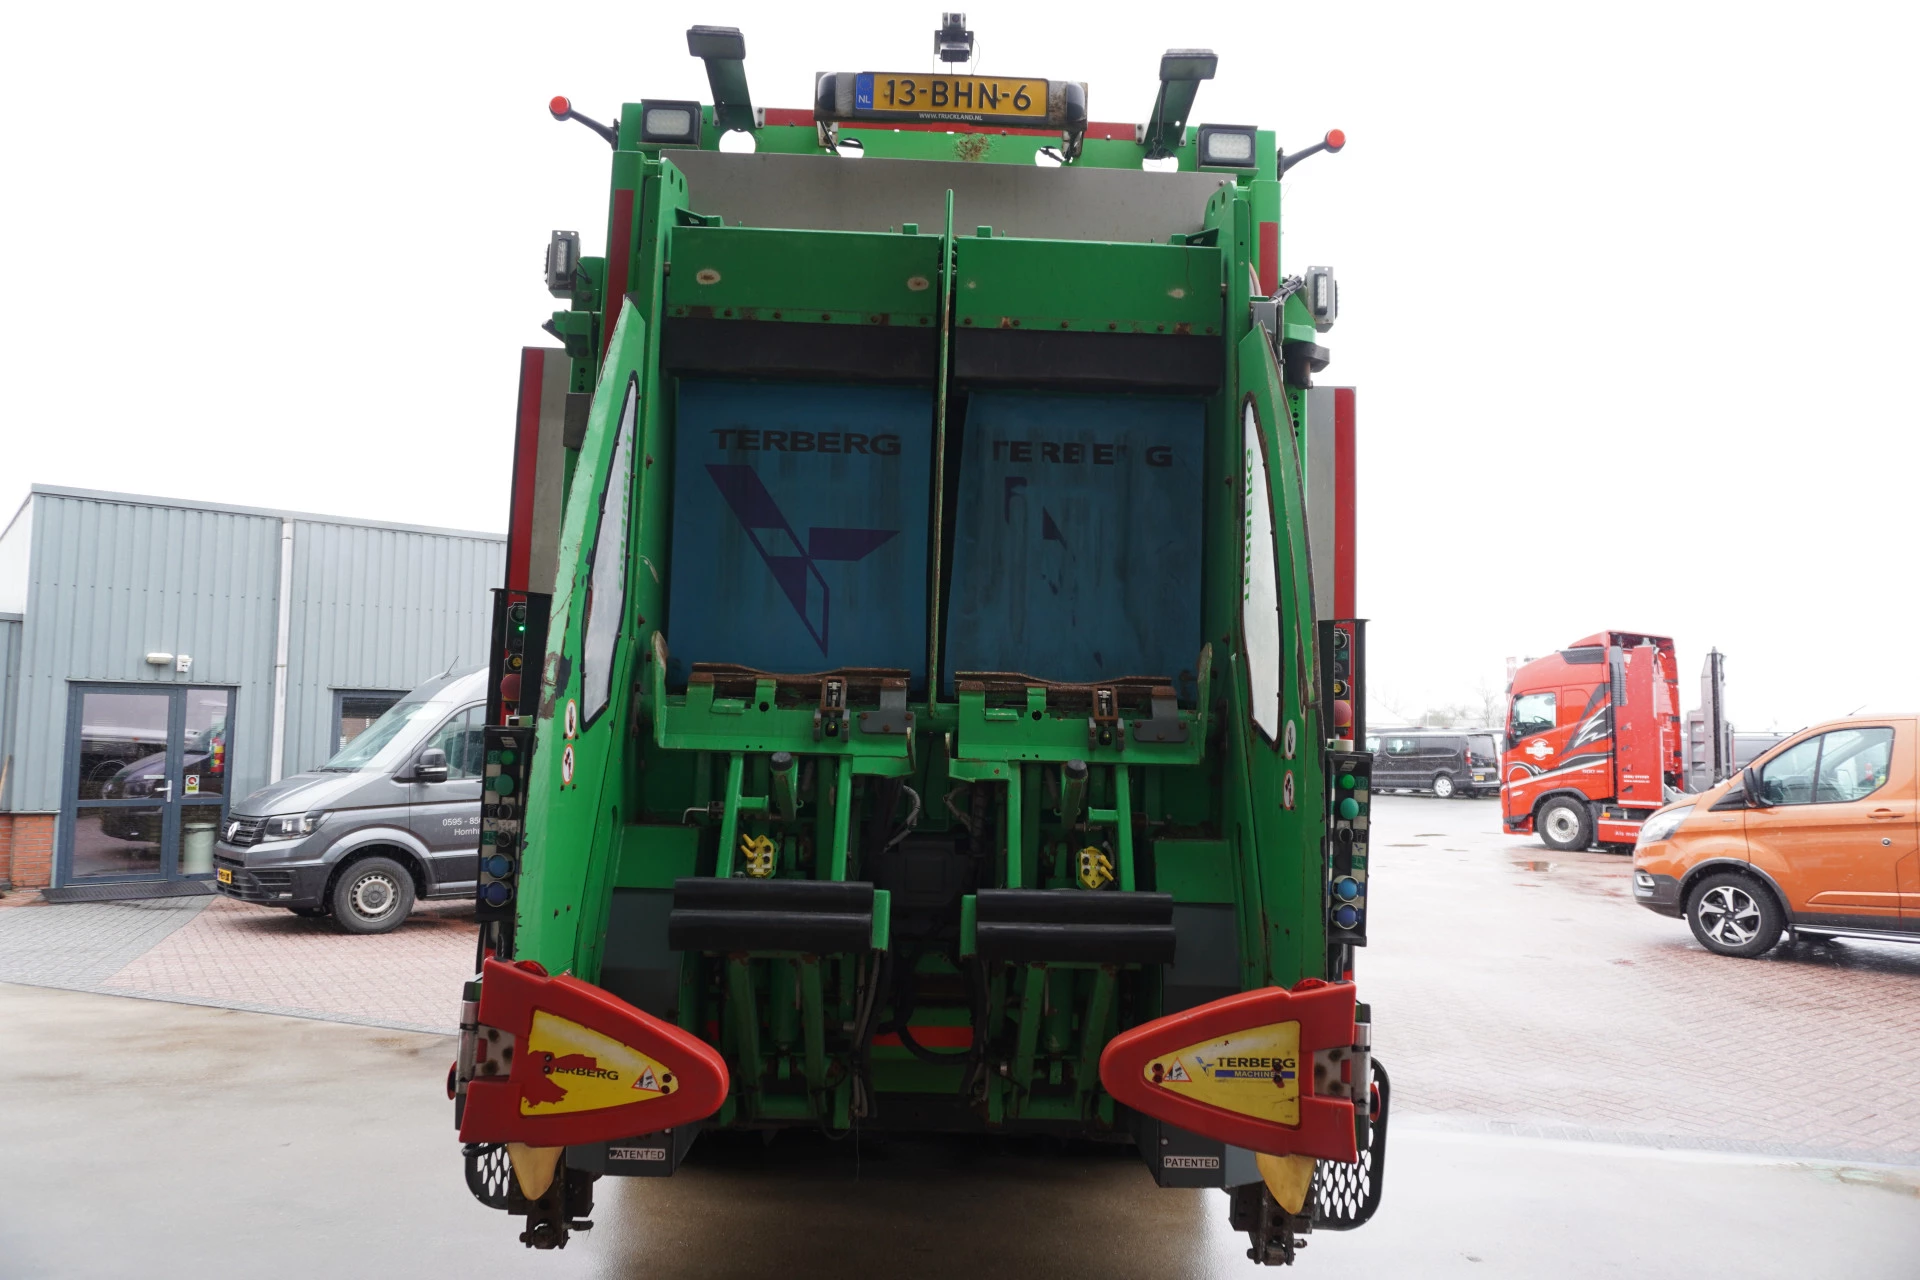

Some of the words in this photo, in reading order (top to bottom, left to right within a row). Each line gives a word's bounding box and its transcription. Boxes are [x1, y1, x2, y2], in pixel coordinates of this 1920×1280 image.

[858, 94, 871, 105] NL
[886, 79, 1032, 111] 13-BHN-6
[918, 112, 983, 121] WWW.TRUCKLAND.NL
[709, 428, 902, 455] TERBERG
[1244, 447, 1253, 605] TERBERG
[442, 818, 462, 826] 0595
[1217, 1057, 1296, 1069] TERBERG
[555, 1067, 619, 1080] ERBERG
[1165, 1157, 1219, 1168] PATENTED
